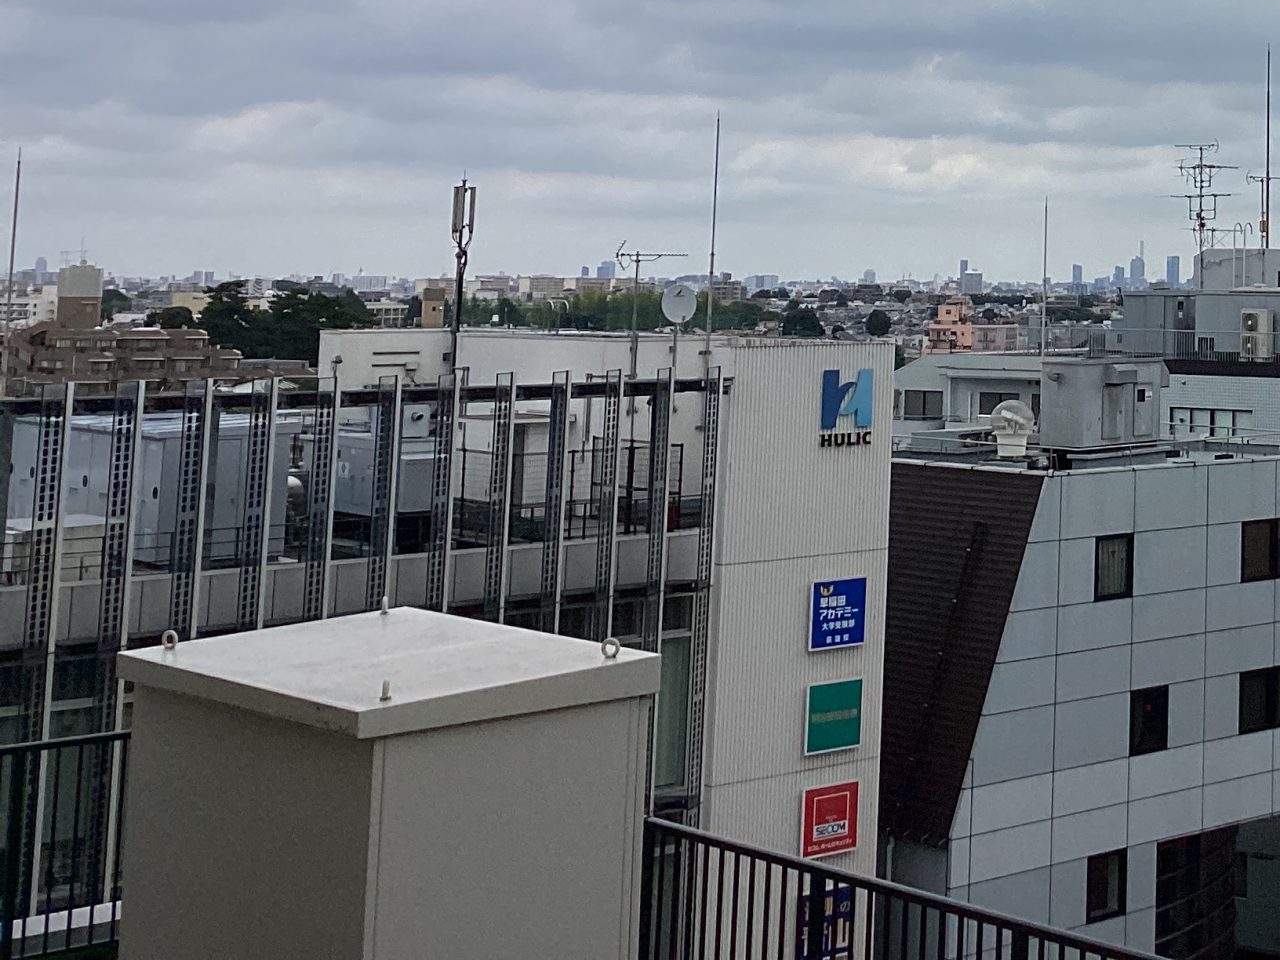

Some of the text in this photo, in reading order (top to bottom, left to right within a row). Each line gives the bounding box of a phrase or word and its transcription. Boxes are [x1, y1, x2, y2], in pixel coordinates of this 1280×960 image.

[820, 430, 872, 448] HULIC
[819, 595, 847, 608] 早稲田
[819, 606, 859, 621] アカデミー
[815, 821, 846, 837] SECOM
